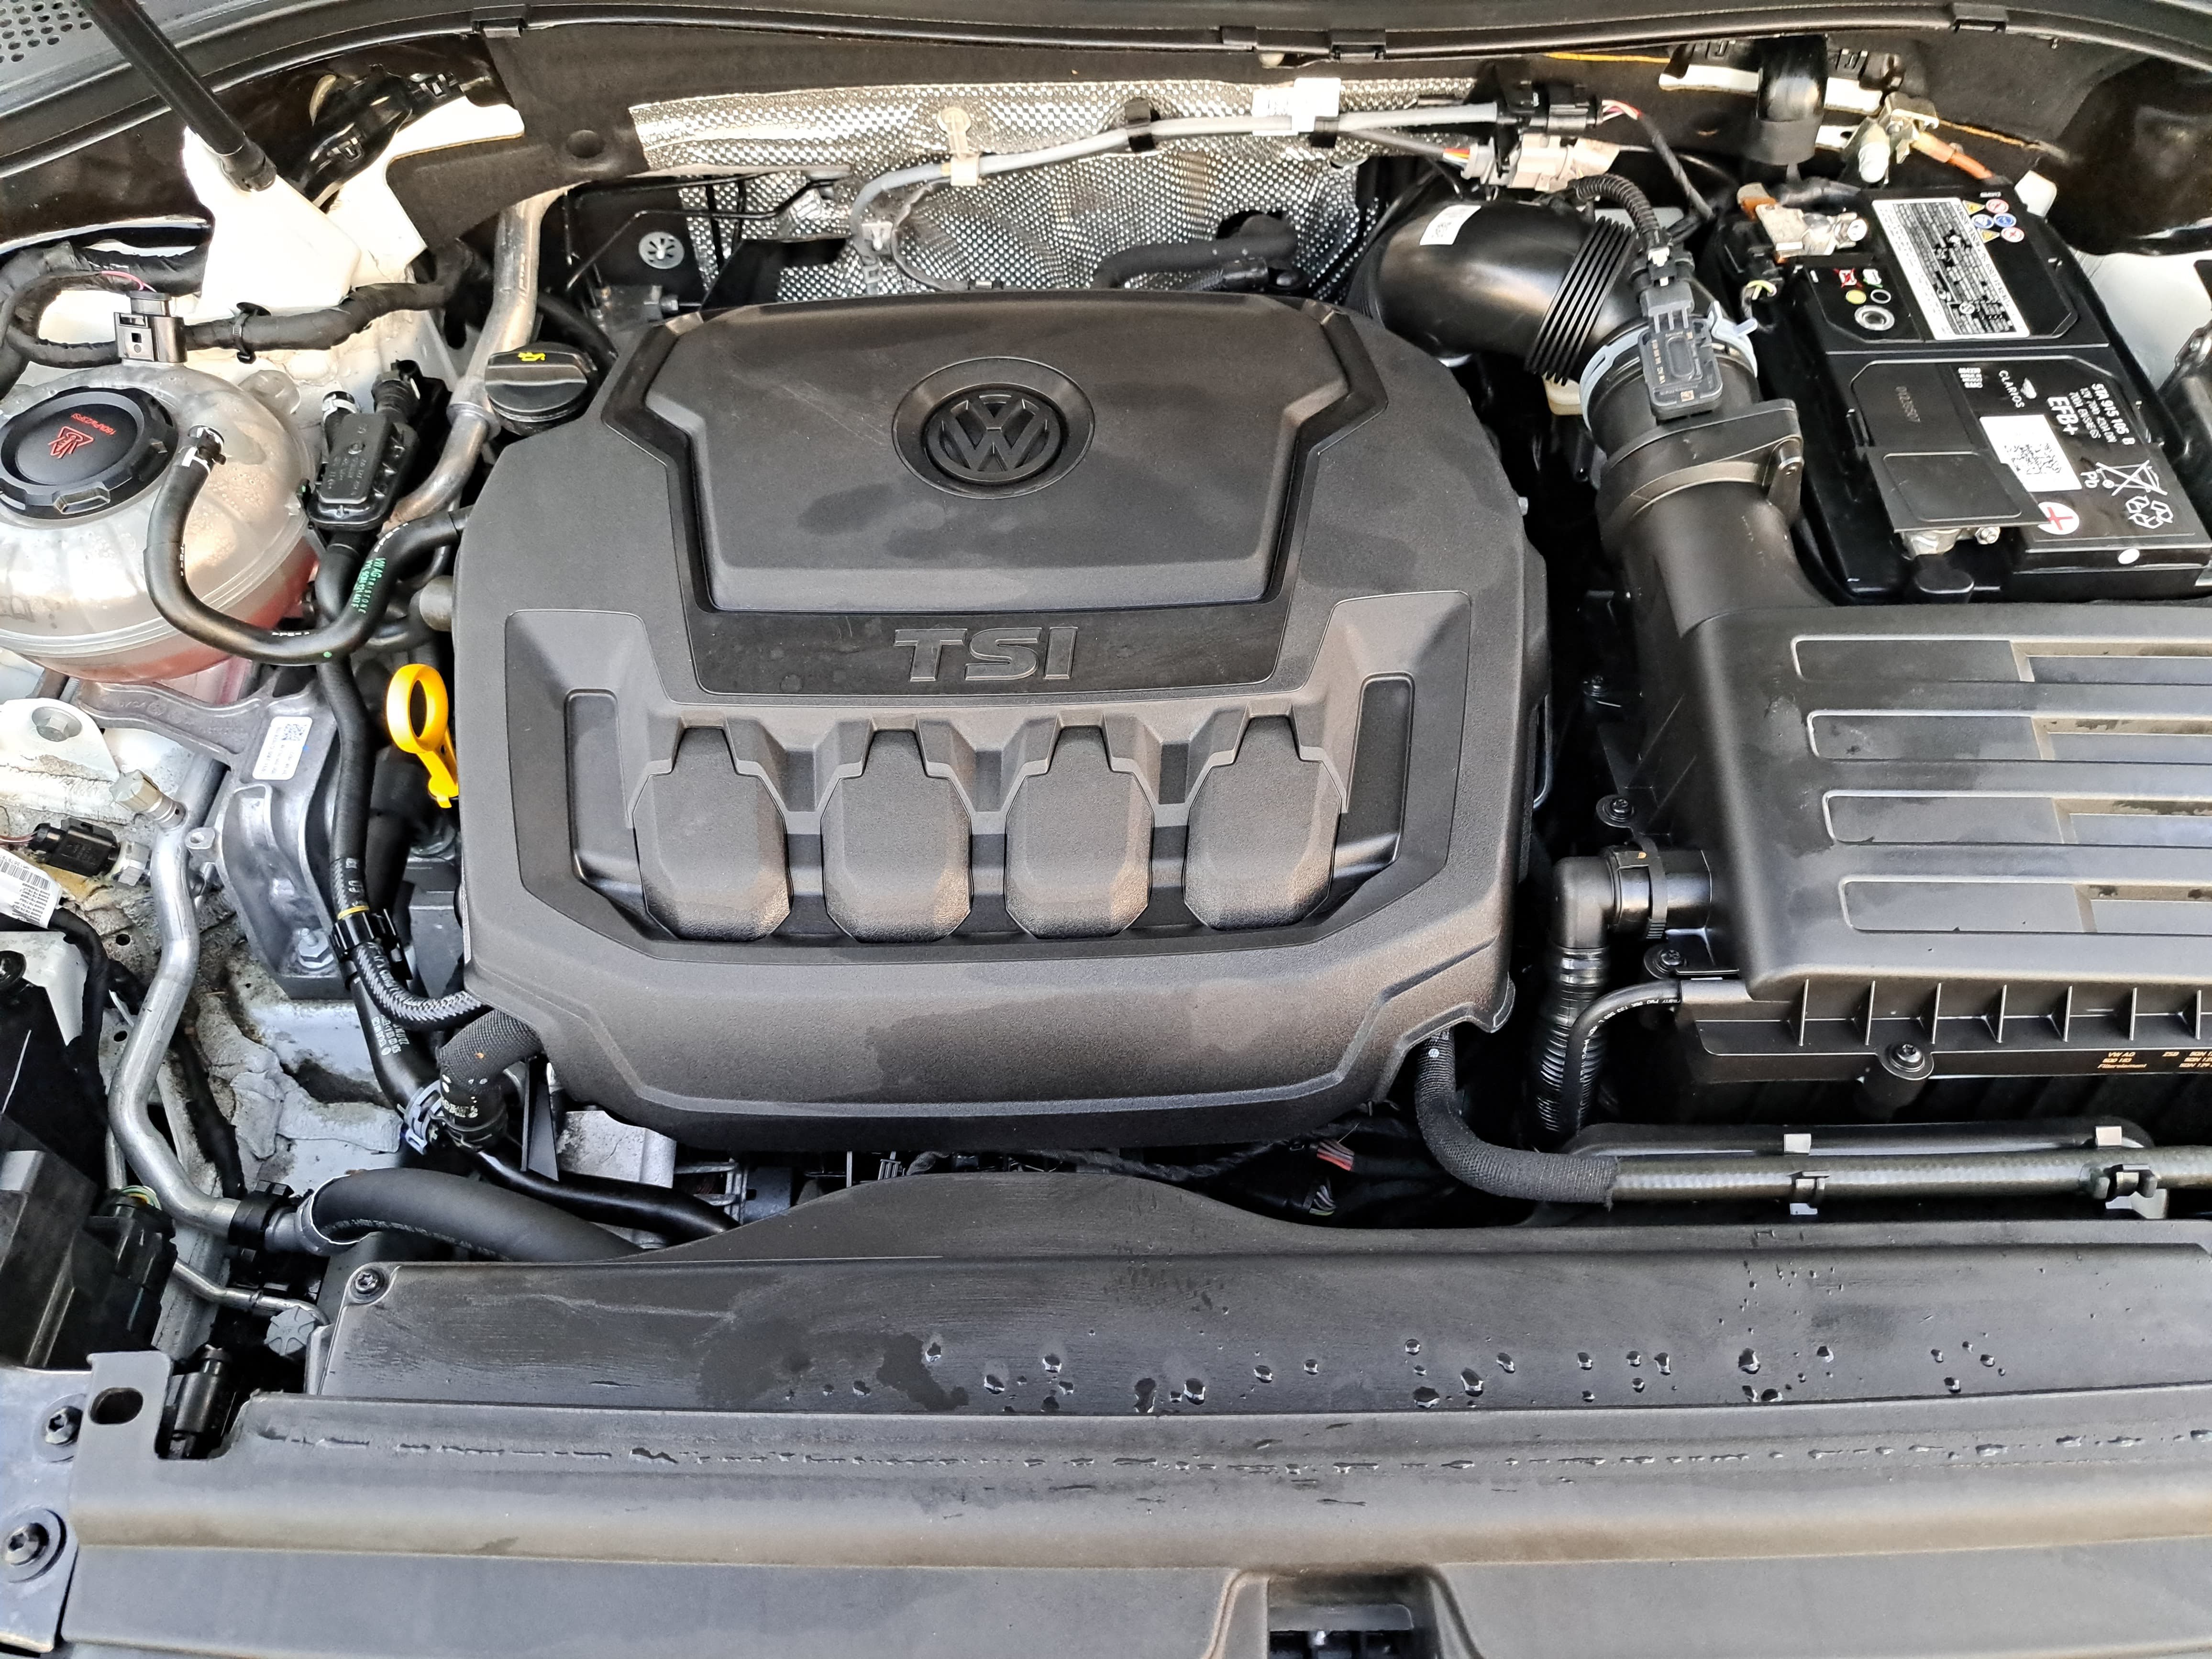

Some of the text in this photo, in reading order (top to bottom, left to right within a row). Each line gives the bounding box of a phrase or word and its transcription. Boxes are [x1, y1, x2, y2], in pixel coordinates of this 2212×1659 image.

[1999, 370, 2025, 408] CLARIOS
[2047, 397, 2079, 436] EFB+
[2091, 384, 2135, 445] 5TA 915 105 B
[2080, 471, 2100, 488] Pb
[894, 626, 1079, 682] TSI
